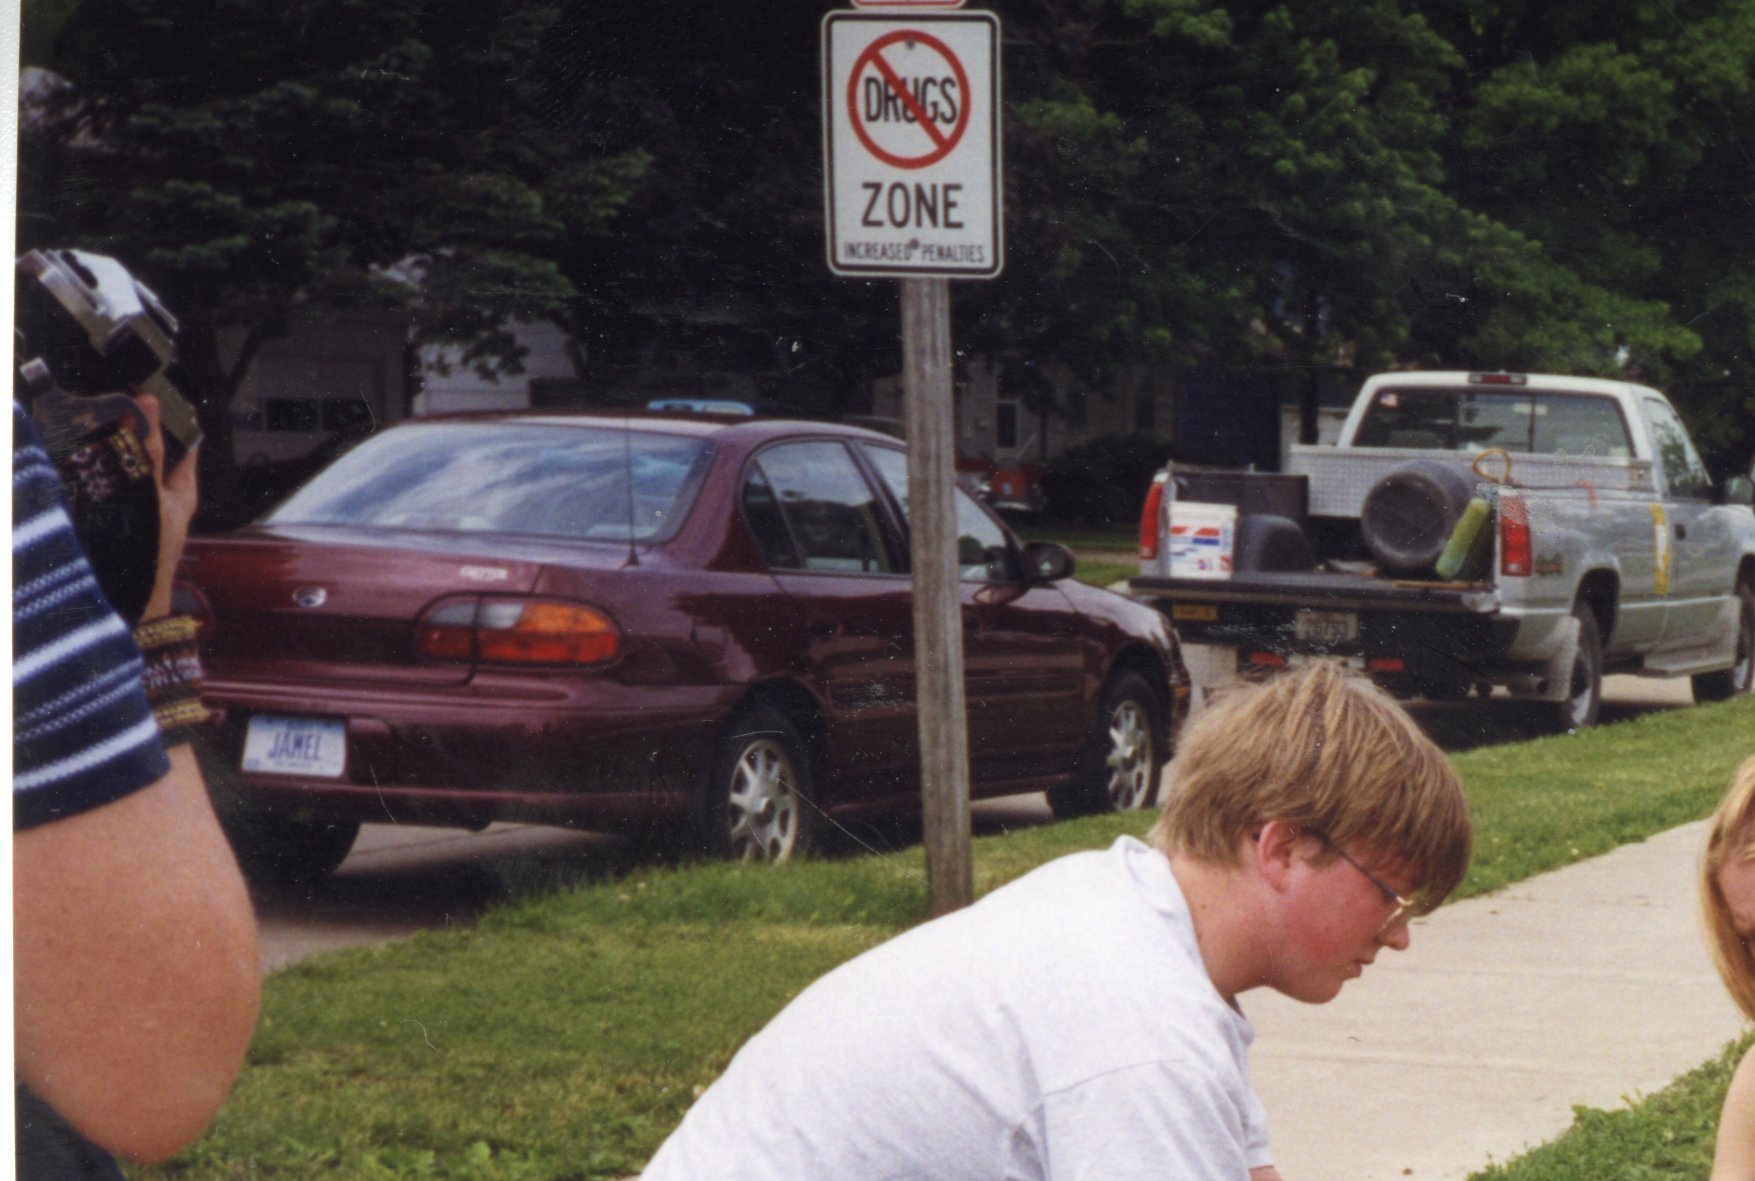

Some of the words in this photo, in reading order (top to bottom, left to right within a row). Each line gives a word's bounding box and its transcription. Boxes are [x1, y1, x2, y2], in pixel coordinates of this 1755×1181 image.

[864, 76, 957, 124] DRUGS
[861, 181, 964, 229] ZONE
[843, 241, 912, 261] INCREASED
[921, 244, 985, 263] PENALTIES
